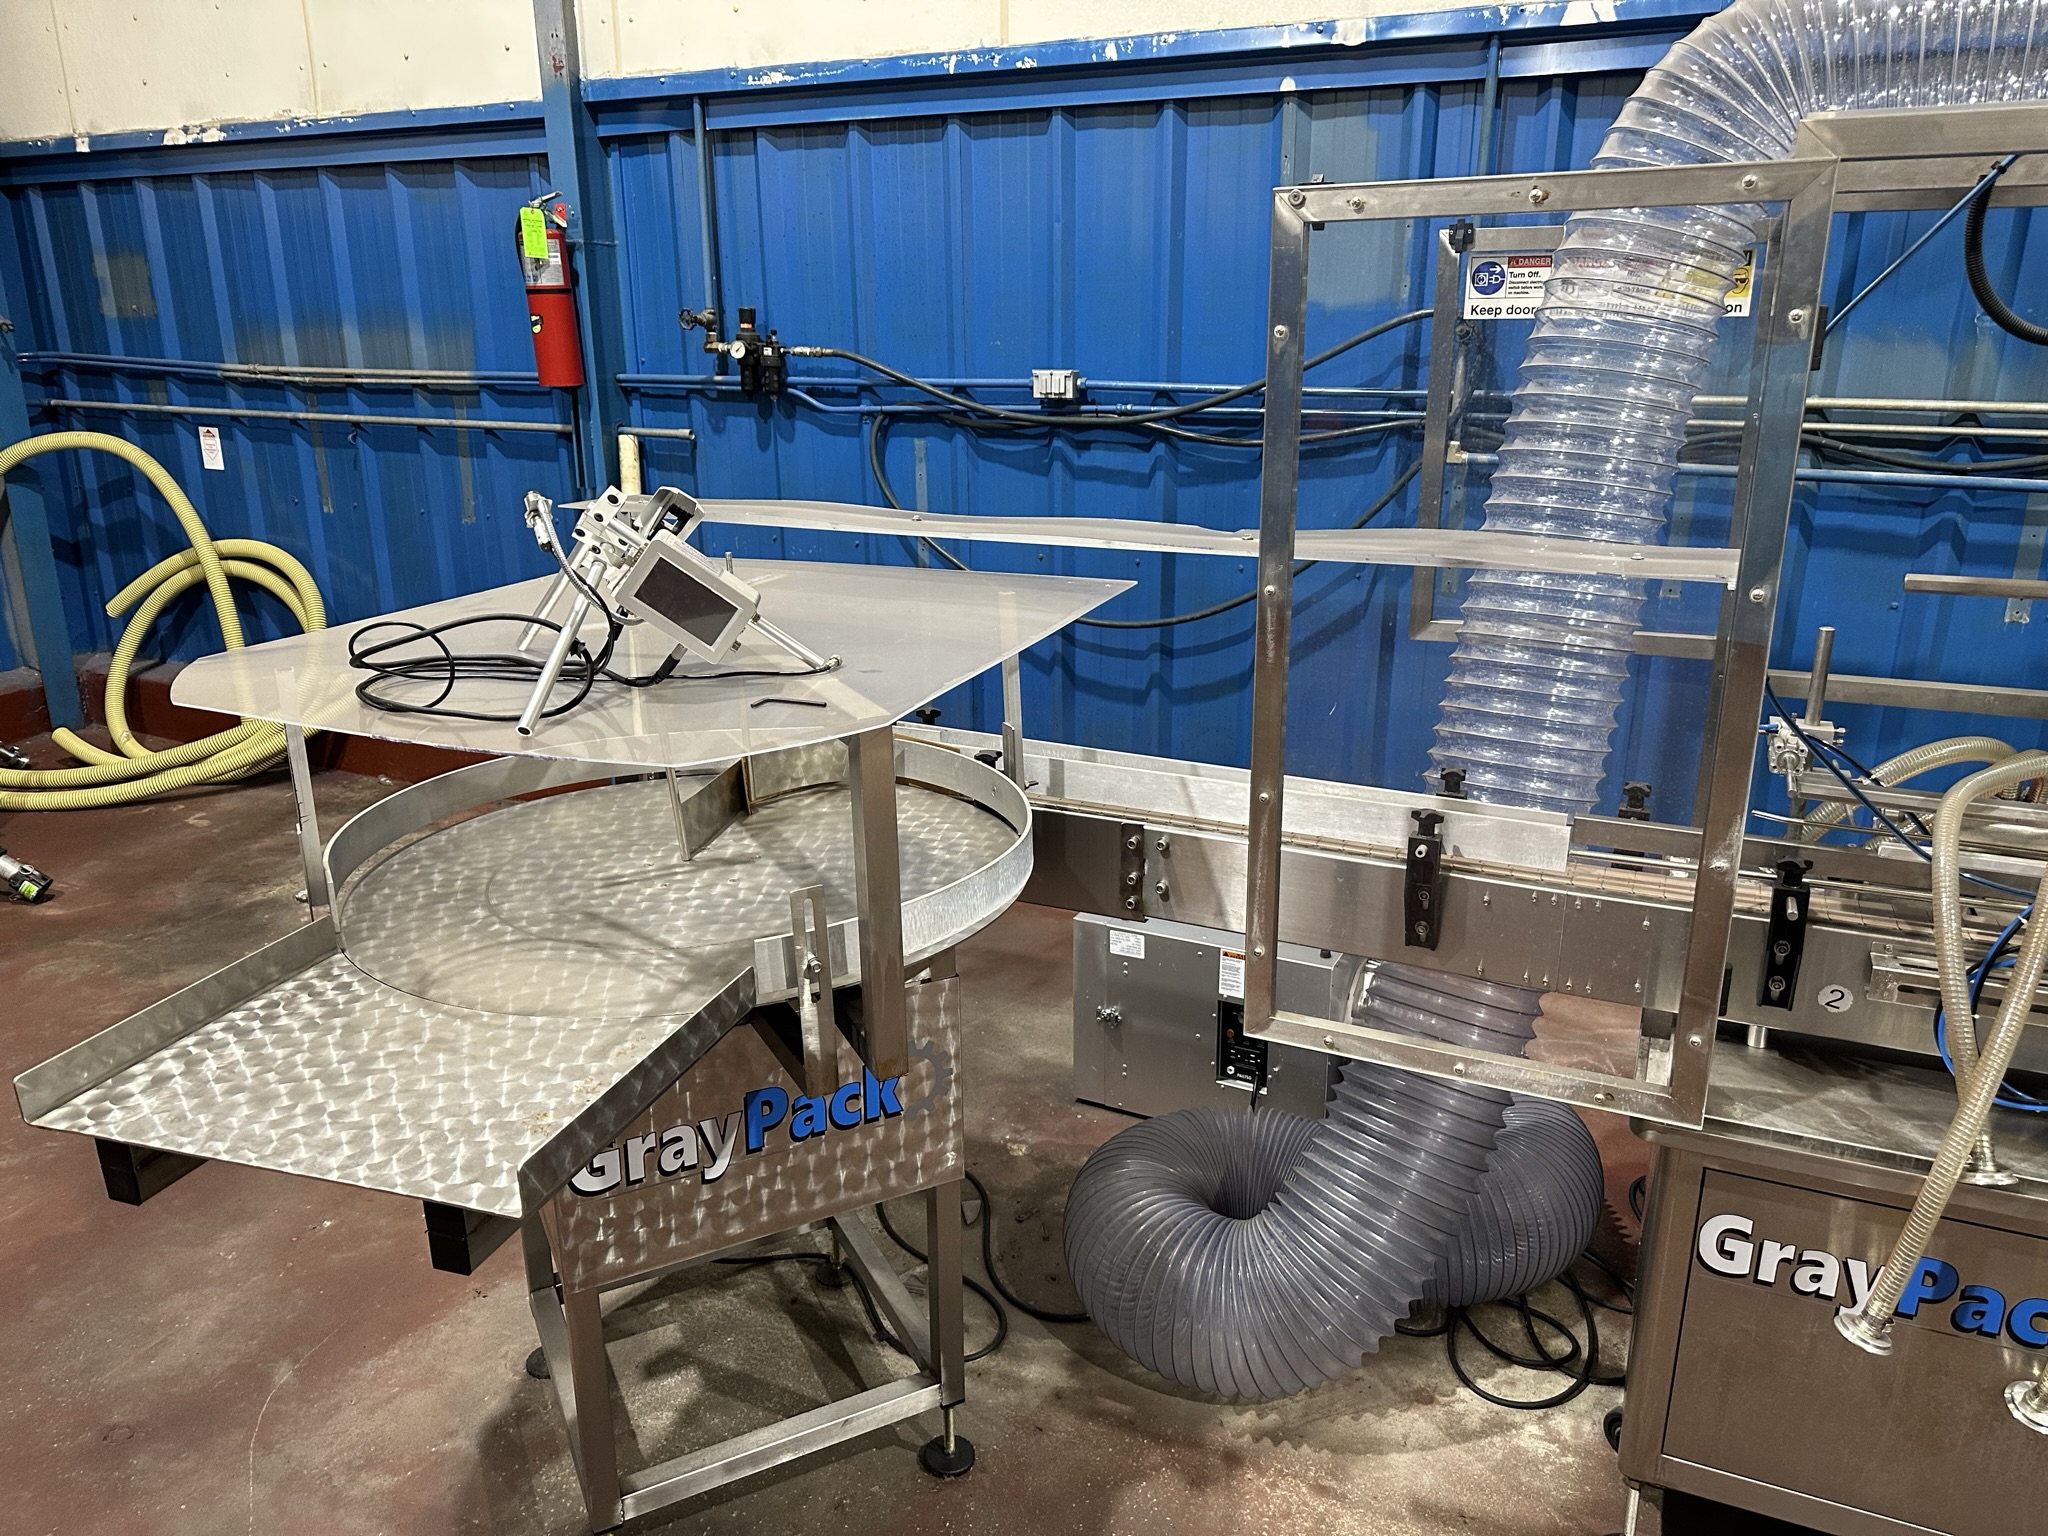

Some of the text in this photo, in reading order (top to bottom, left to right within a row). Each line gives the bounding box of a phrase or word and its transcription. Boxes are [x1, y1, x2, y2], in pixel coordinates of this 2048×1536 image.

[1471, 305, 1502, 317] Keep
[1824, 989, 1845, 1010] 2
[567, 1064, 905, 1197] GrayPack
[1696, 1213, 2048, 1347] GrayPac
